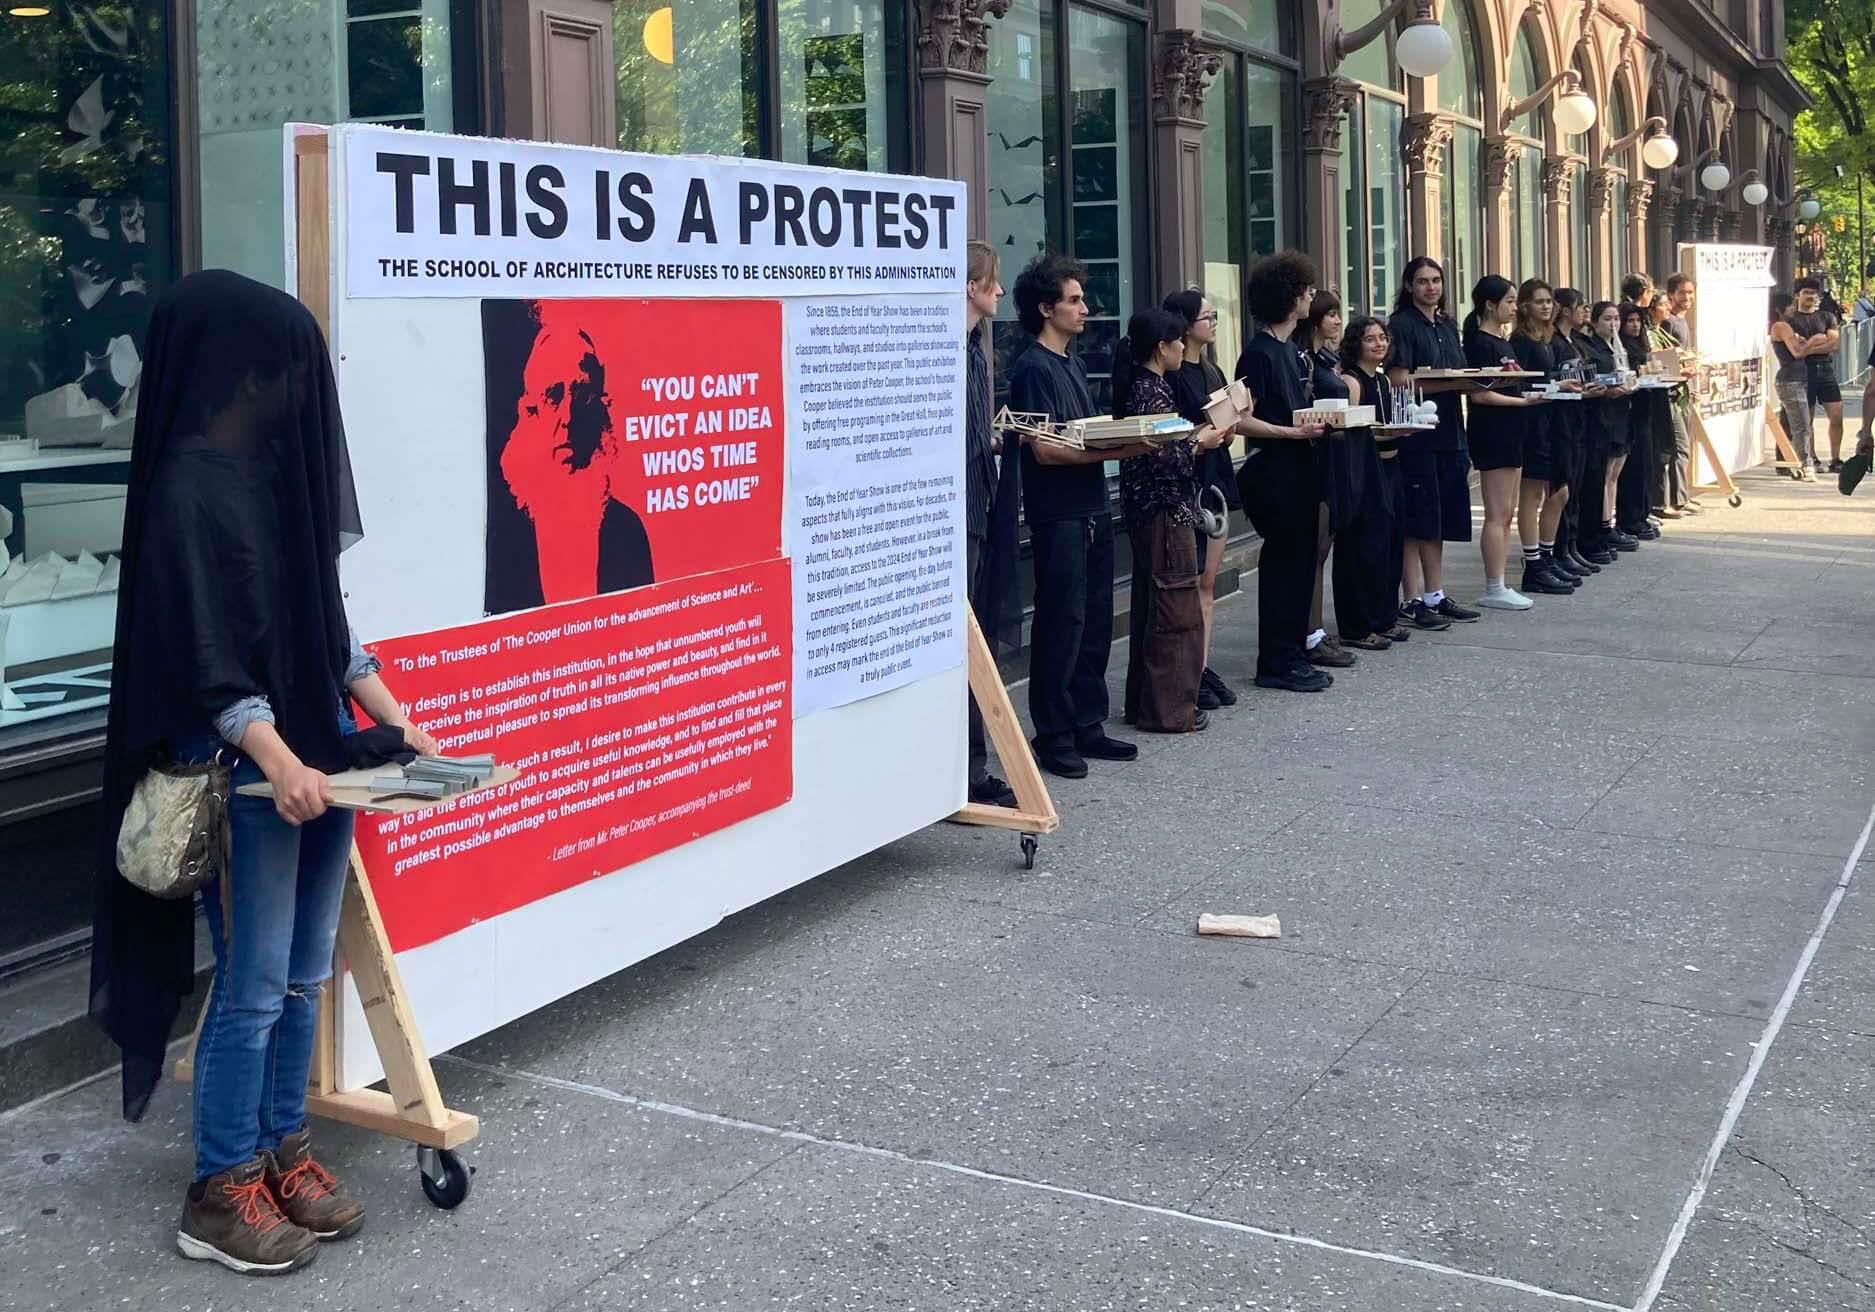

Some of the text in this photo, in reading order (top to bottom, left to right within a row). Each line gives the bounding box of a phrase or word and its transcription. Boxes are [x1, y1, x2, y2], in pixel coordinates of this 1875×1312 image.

[376, 152, 954, 249] THIS IS A PROTEST
[377, 258, 955, 280] THE SCHOOL OF ARCHITECTURE REFUSES TO BE CENSORED BY THIS ADMINISTRATION
[626, 407, 772, 441] EVICT AN IDEA
[641, 373, 758, 401] “YOU CAN’T
[643, 442, 756, 476] WHOS TIME
[647, 475, 759, 513] HAS COME”
[825, 491, 836, 504] the
[836, 489, 848, 502] End
[849, 488, 855, 500] of
[855, 487, 868, 498] Year
[868, 485, 884, 497] Show
[885, 484, 890, 494] is
[890, 483, 901, 493] one
[902, 481, 908, 492] of
[908, 480, 917, 490] the
[917, 479, 927, 488] few
[928, 475, 953, 487] remaining
[415, 693, 456, 712] design
[459, 688, 469, 702] is
[471, 686, 483, 699] to
[485, 672, 529, 696] establish
[531, 668, 551, 683] this
[552, 657, 605, 678] institution,
[607, 653, 617, 665] in
[618, 649, 633, 662] the
[635, 644, 654, 659] hope
[655, 638, 671, 652] that
[673, 625, 723, 647] unnumbered
[724, 620, 746, 637] youth
[747, 616, 761, 628] will
[417, 653, 437, 668] the
[439, 644, 487, 663] Trustees
[489, 637, 500, 653] of
[526, 627, 561, 644] Cooper
[563, 620, 591, 635] Union
[593, 616, 608, 629] for
[610, 612, 626, 625] the
[627, 598, 680, 622] advancement
[681, 596, 689, 608] of
[690, 591, 721, 606] Science
[722, 586, 737, 599] and
[417, 631, 766, 732] receive the inspiration of truth in all its native power and beauty, and find in it
[438, 723, 493, 754] perpetual
[495, 713, 538, 738] pleasure
[539, 709, 550, 721] to
[552, 697, 587, 720] spread
[589, 696, 602, 708] its
[603, 680, 659, 705] transforming
[661, 670, 699, 688] influence
[700, 655, 742, 677] throughout
[743, 653, 756, 665] the
[517, 680, 786, 769] such a result, I desire to make this institution contribute in every
[378, 813, 400, 834] way
[402, 807, 416, 825] to
[437, 799, 457, 814] the
[459, 788, 495, 808] efforts
[498, 780, 511, 796] of
[507, 772, 536, 796] youth
[538, 770, 549, 782] to
[551, 758, 590, 779] acquire
[592, 747, 621, 767] useful
[623, 734, 672, 758] knowledge,
[674, 725, 689, 741] and
[690, 724, 699, 735] to
[701, 717, 716, 732] find
[717, 712, 733, 726] and
[734, 708, 744, 721] fill
[745, 704, 761, 718] that
[761, 698, 782, 715] place
[387, 718, 776, 854] in the community where their capacity and talents can be usefully employed with the
[394, 844, 440, 875] greatest
[443, 830, 491, 859] possible
[493, 812, 545, 839] advantage
[546, 808, 557, 820] to
[559, 790, 615, 816] themselves
[616, 780, 634, 797] and
[636, 777, 651, 791] the
[652, 761, 699, 785] community
[700, 757, 708, 768] in
[709, 747, 733, 765] which
[734, 743, 752, 757] they
